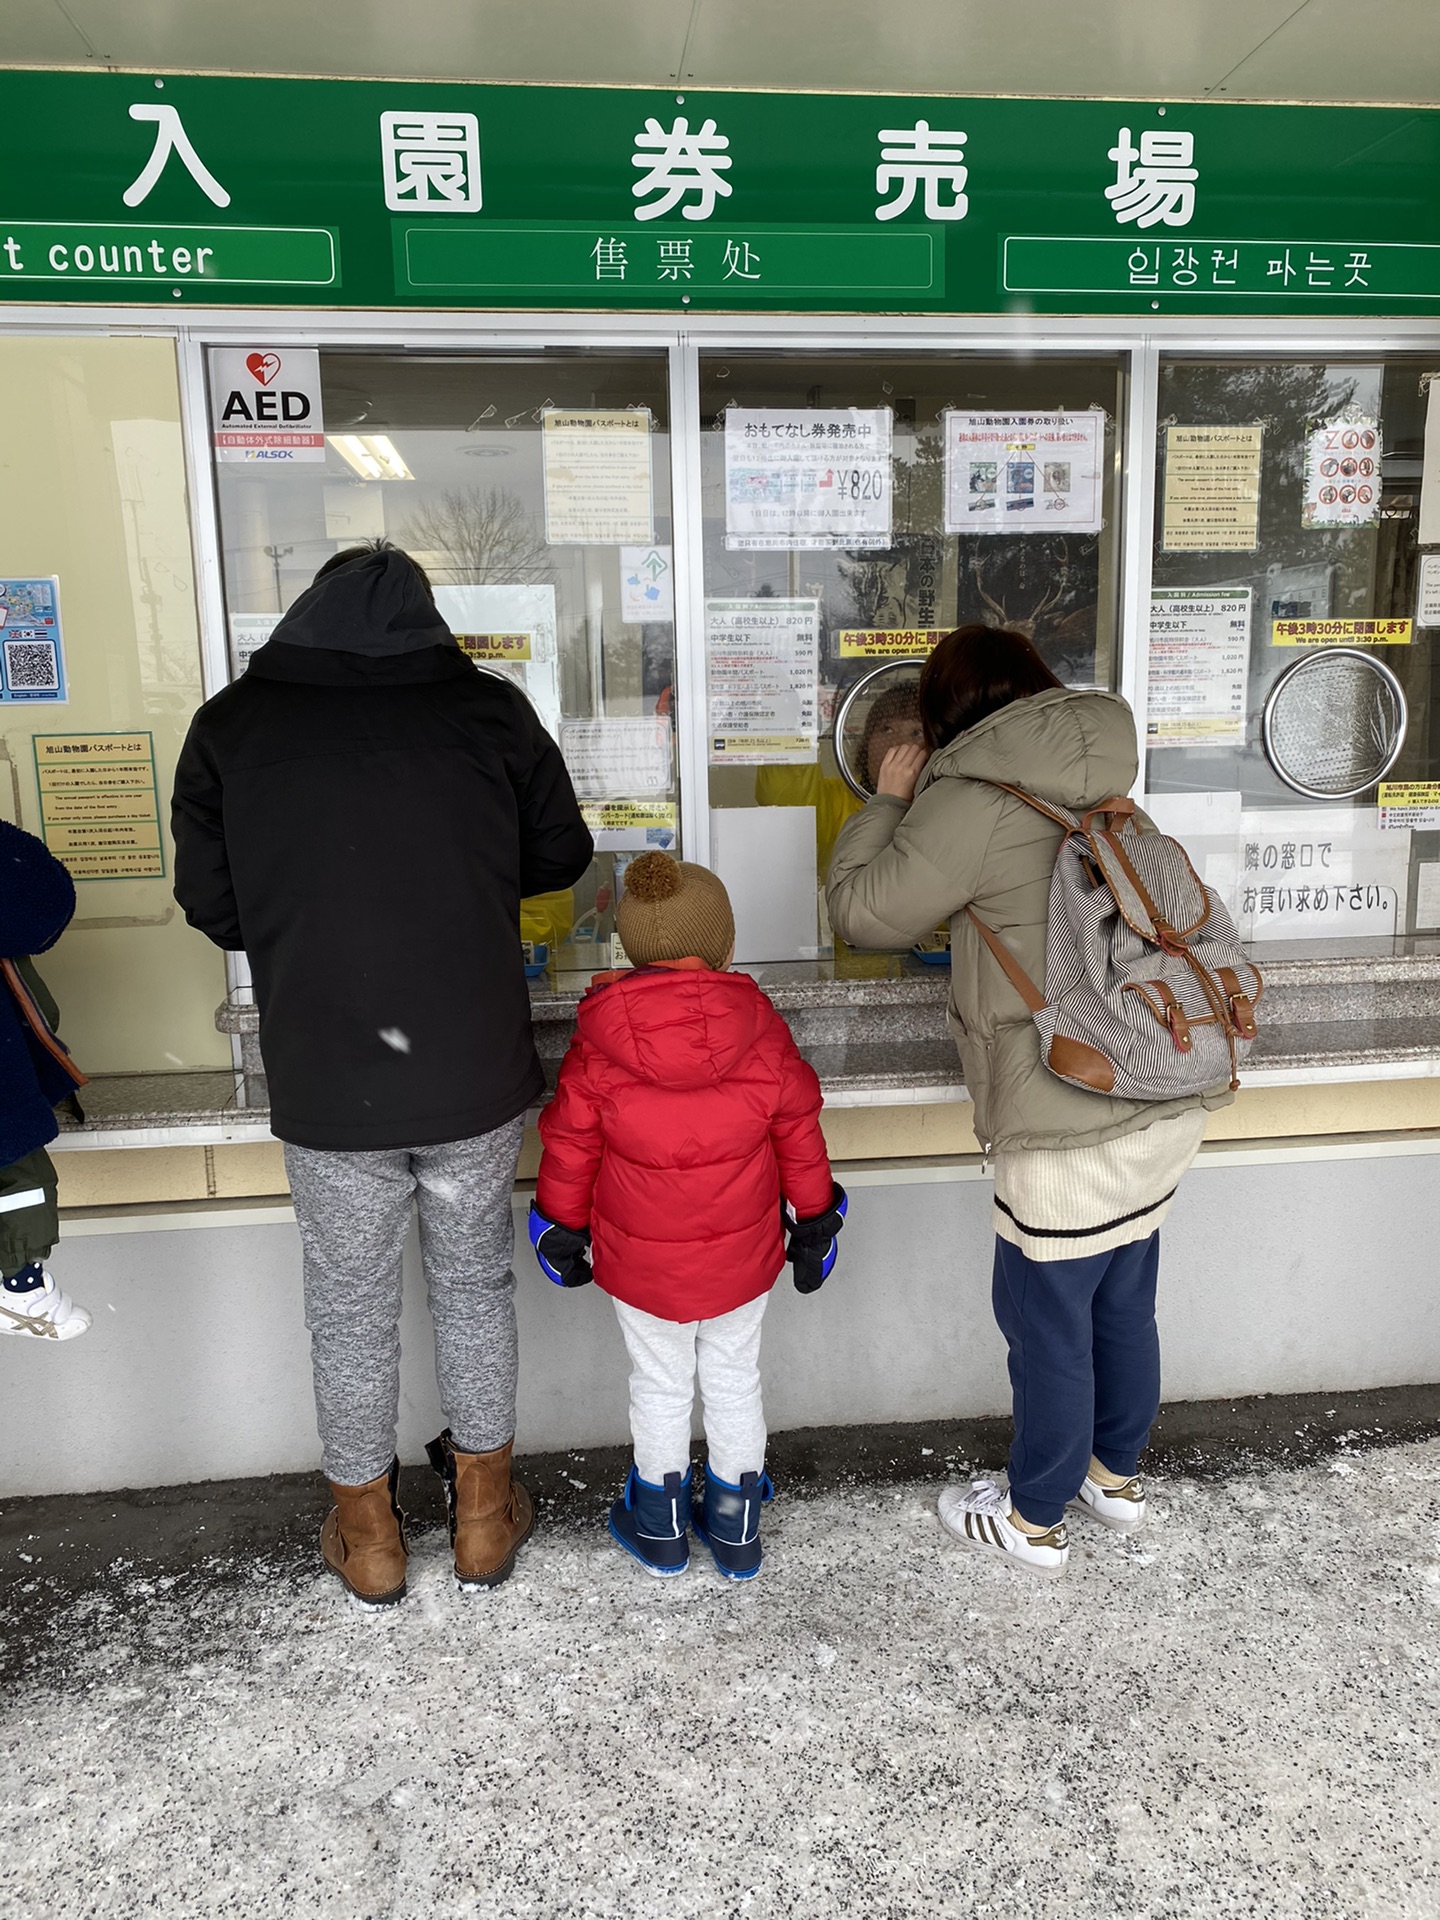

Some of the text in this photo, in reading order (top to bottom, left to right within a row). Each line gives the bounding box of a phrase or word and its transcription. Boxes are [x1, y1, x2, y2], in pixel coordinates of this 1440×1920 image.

[123, 103, 1198, 228] 入園券売場
[49, 240, 213, 273] counter
[590, 237, 761, 280] 售票处
[1128, 247, 1239, 285] 입장권
[222, 391, 311, 421] AED
[968, 417, 1074, 426] 旭山動物園入園券の取り扱い
[744, 422, 871, 439] おもてなし券発売中
[256, 450, 294, 459] ALSOK
[837, 469, 882, 500] ¥820
[918, 535, 935, 629] 日本の野生
[1150, 604, 1215, 613] 大人（高校生以上）
[710, 616, 779, 625] 大人（高校生以上）
[1150, 620, 1245, 630] 中学生以下 無料
[1276, 621, 1409, 636] 午後3時30分に閉園します
[710, 633, 813, 642] 中学生以下 無料
[1296, 636, 1306, 644] We
[1321, 636, 1337, 644] open
[1340, 635, 1354, 643] until
[1356, 635, 1372, 643] 3:30
[1373, 636, 1388, 644] p.m.
[488, 652, 506, 660] p.m.
[864, 647, 875, 655] We
[892, 647, 909, 656] open
[912, 646, 927, 654] until
[46, 744, 142, 754] 旭山動物園パスポートとは
[1244, 841, 1332, 871] 隣の窓口で
[1242, 883, 1388, 914] お買い求め下さい。
